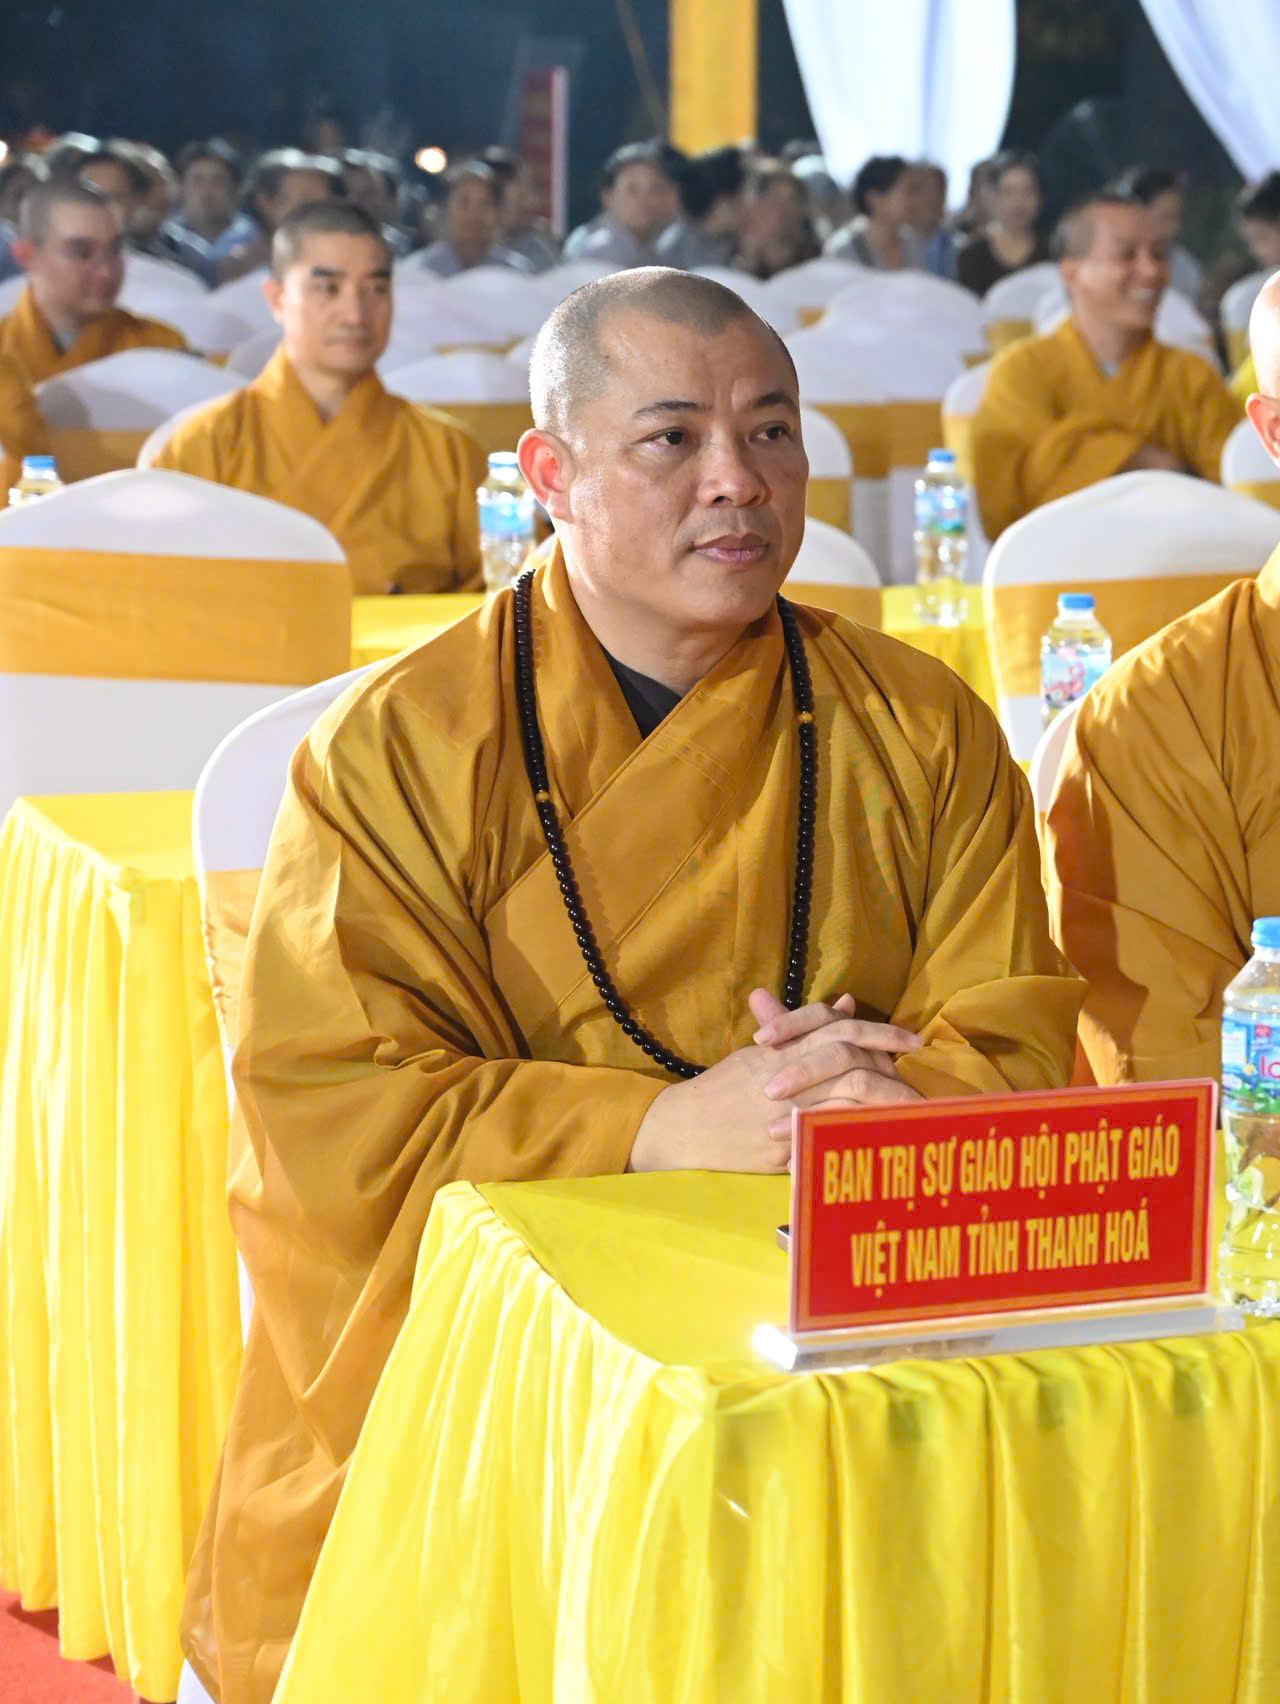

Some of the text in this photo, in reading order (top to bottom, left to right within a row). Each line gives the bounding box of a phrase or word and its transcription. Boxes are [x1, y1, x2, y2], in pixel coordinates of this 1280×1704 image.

[823, 1113, 1180, 1211] BAN TRỊ SỰ GIÁO HỘI PHẬT GIÁO
[851, 1197, 1150, 1299] VIỆT NAM TỈNH THANH HOÁ
